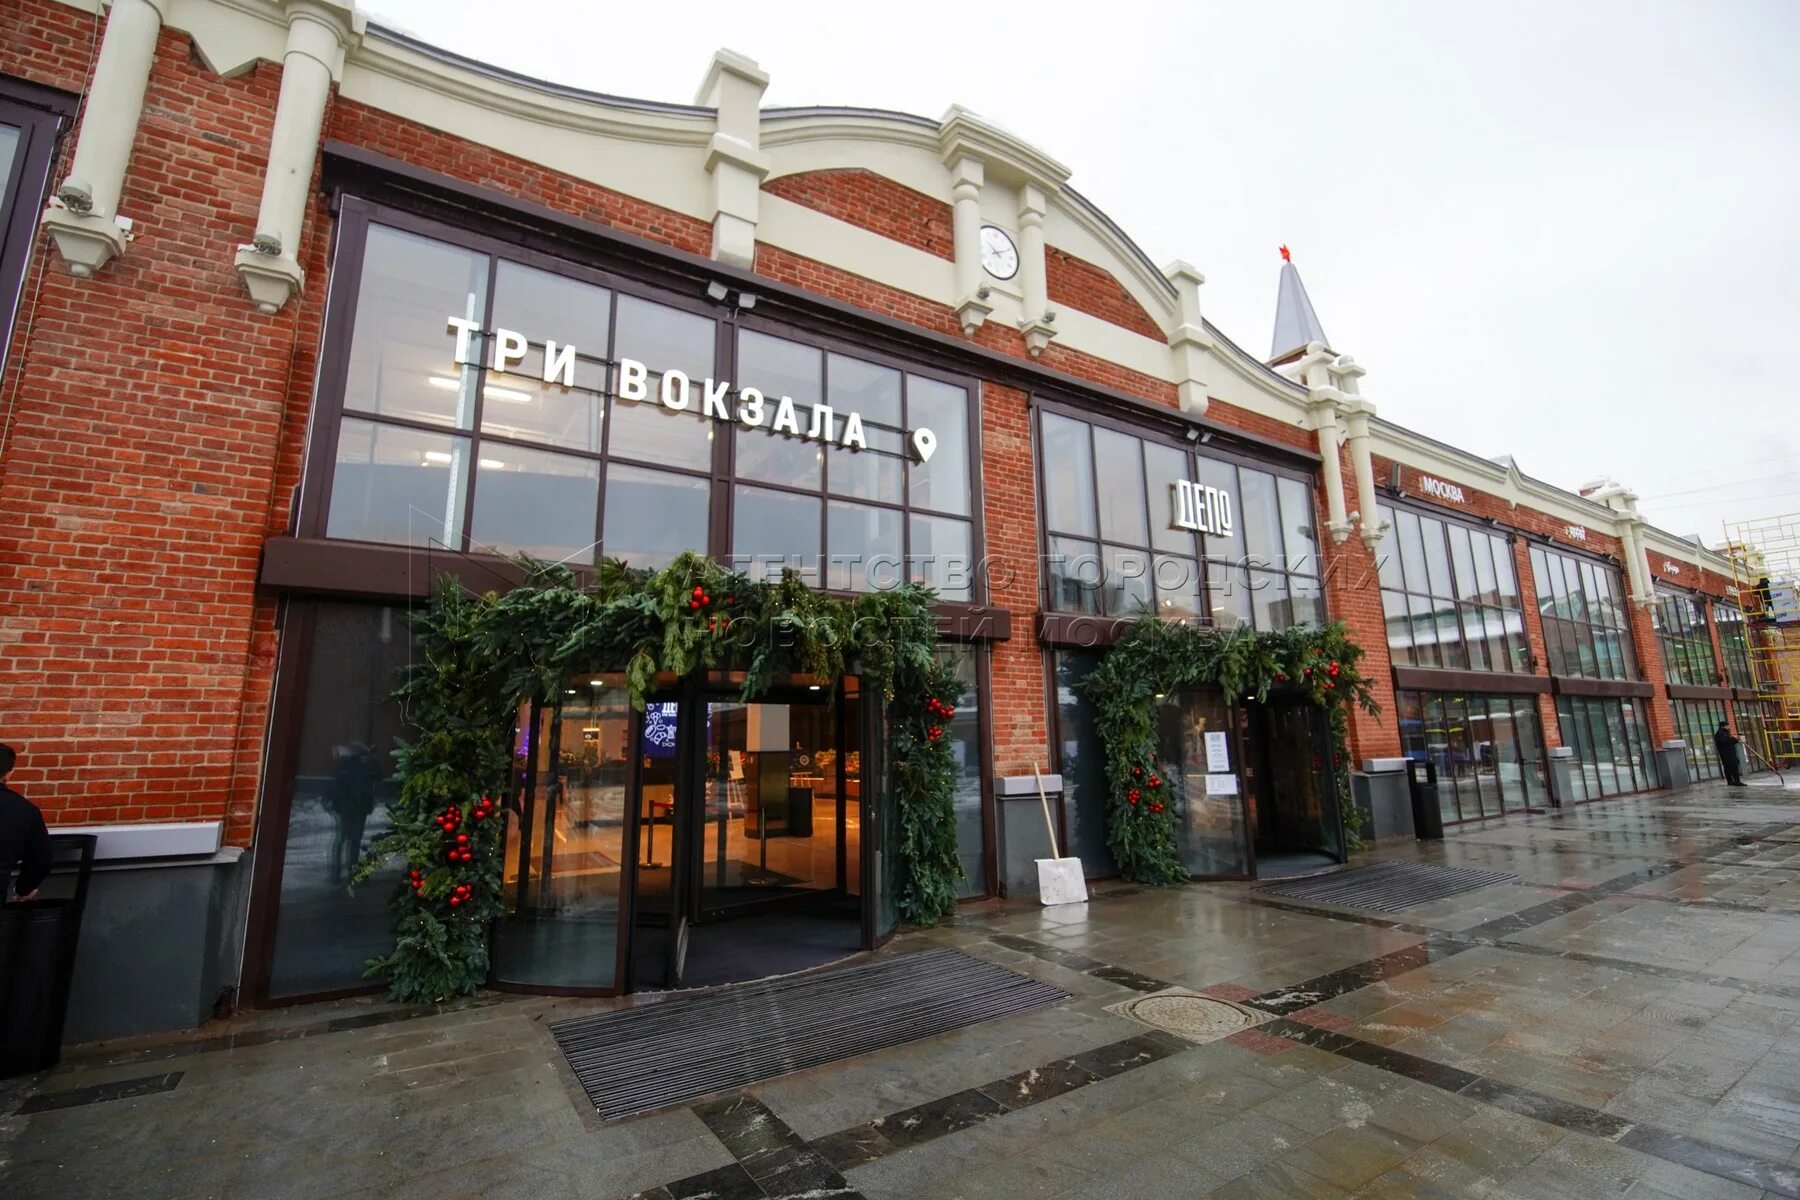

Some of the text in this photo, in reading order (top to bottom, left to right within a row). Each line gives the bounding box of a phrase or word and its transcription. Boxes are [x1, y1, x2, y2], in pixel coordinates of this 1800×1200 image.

[446, 315, 868, 450] ТРИ ВОКЗАЛА
[1175, 478, 1234, 538] ДЕПО
[1422, 475, 1465, 504] МОСКВА
